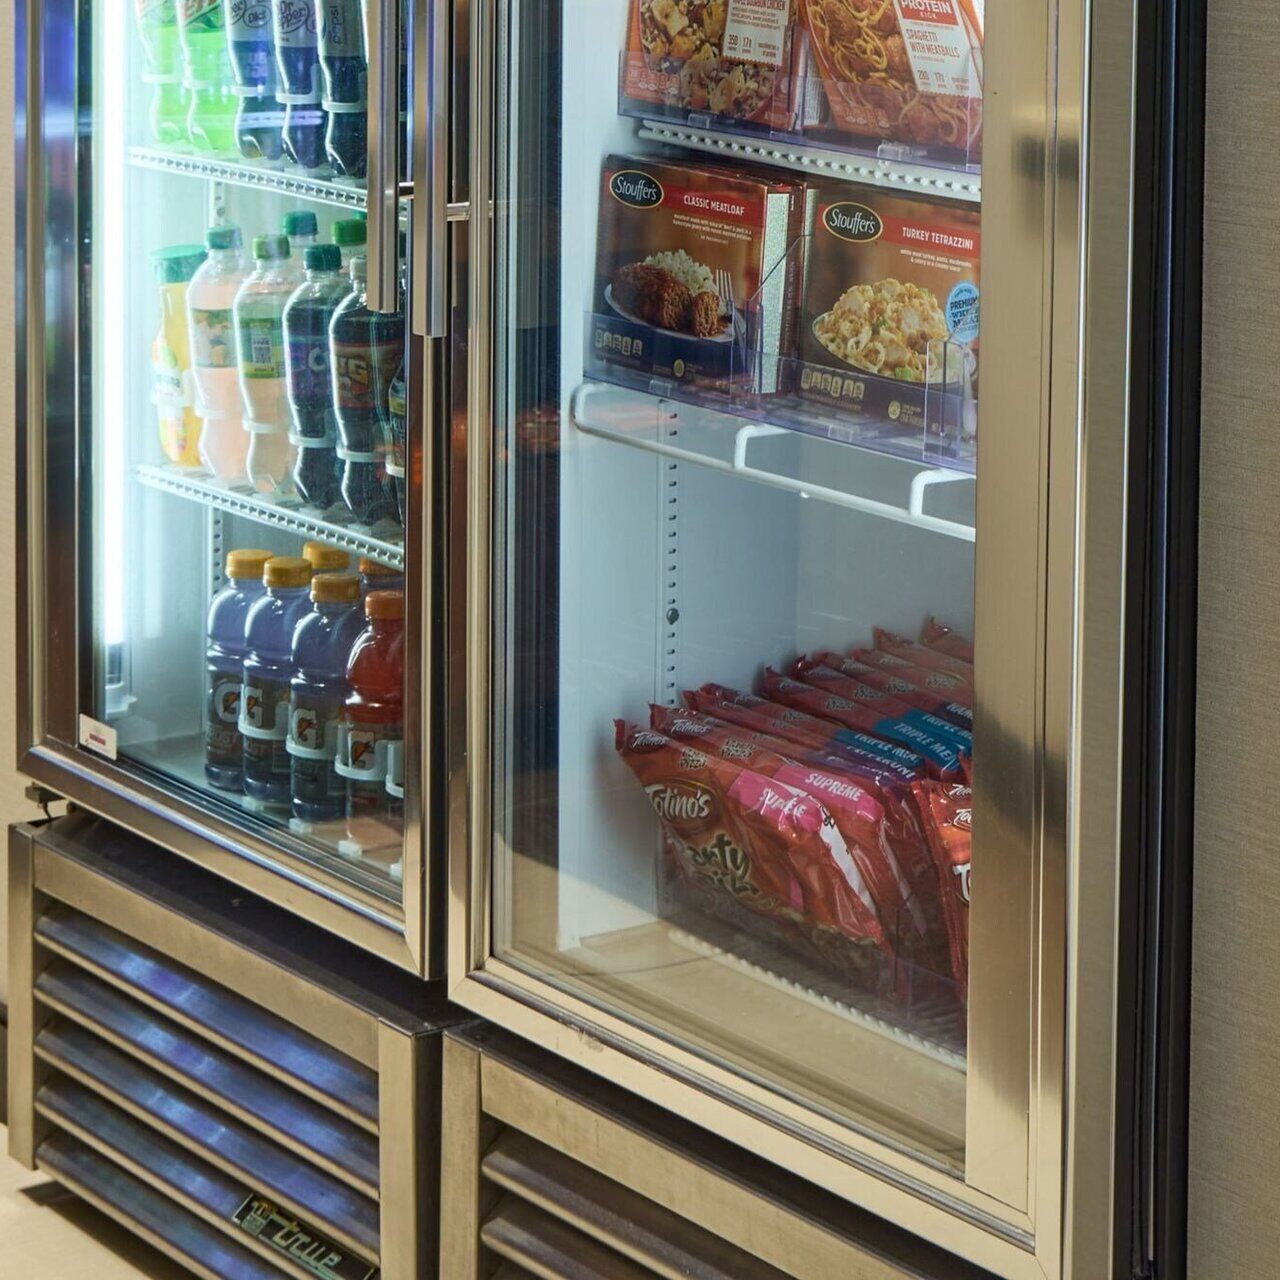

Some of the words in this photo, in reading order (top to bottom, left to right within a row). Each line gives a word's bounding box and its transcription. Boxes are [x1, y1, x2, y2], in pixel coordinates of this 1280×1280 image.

[615, 175, 658, 201] Stouffer's
[683, 194, 710, 210] CLASSIC
[710, 200, 745, 216] MEATLOAF
[829, 207, 876, 236] Stouffer's
[902, 226, 929, 241] TURKEY
[931, 232, 974, 251] TETRAZZINI
[894, 722, 934, 745] TRIPLE
[805, 772, 865, 802] SUPREME
[644, 783, 712, 821] Totino's
[271, 1215, 343, 1267] true
